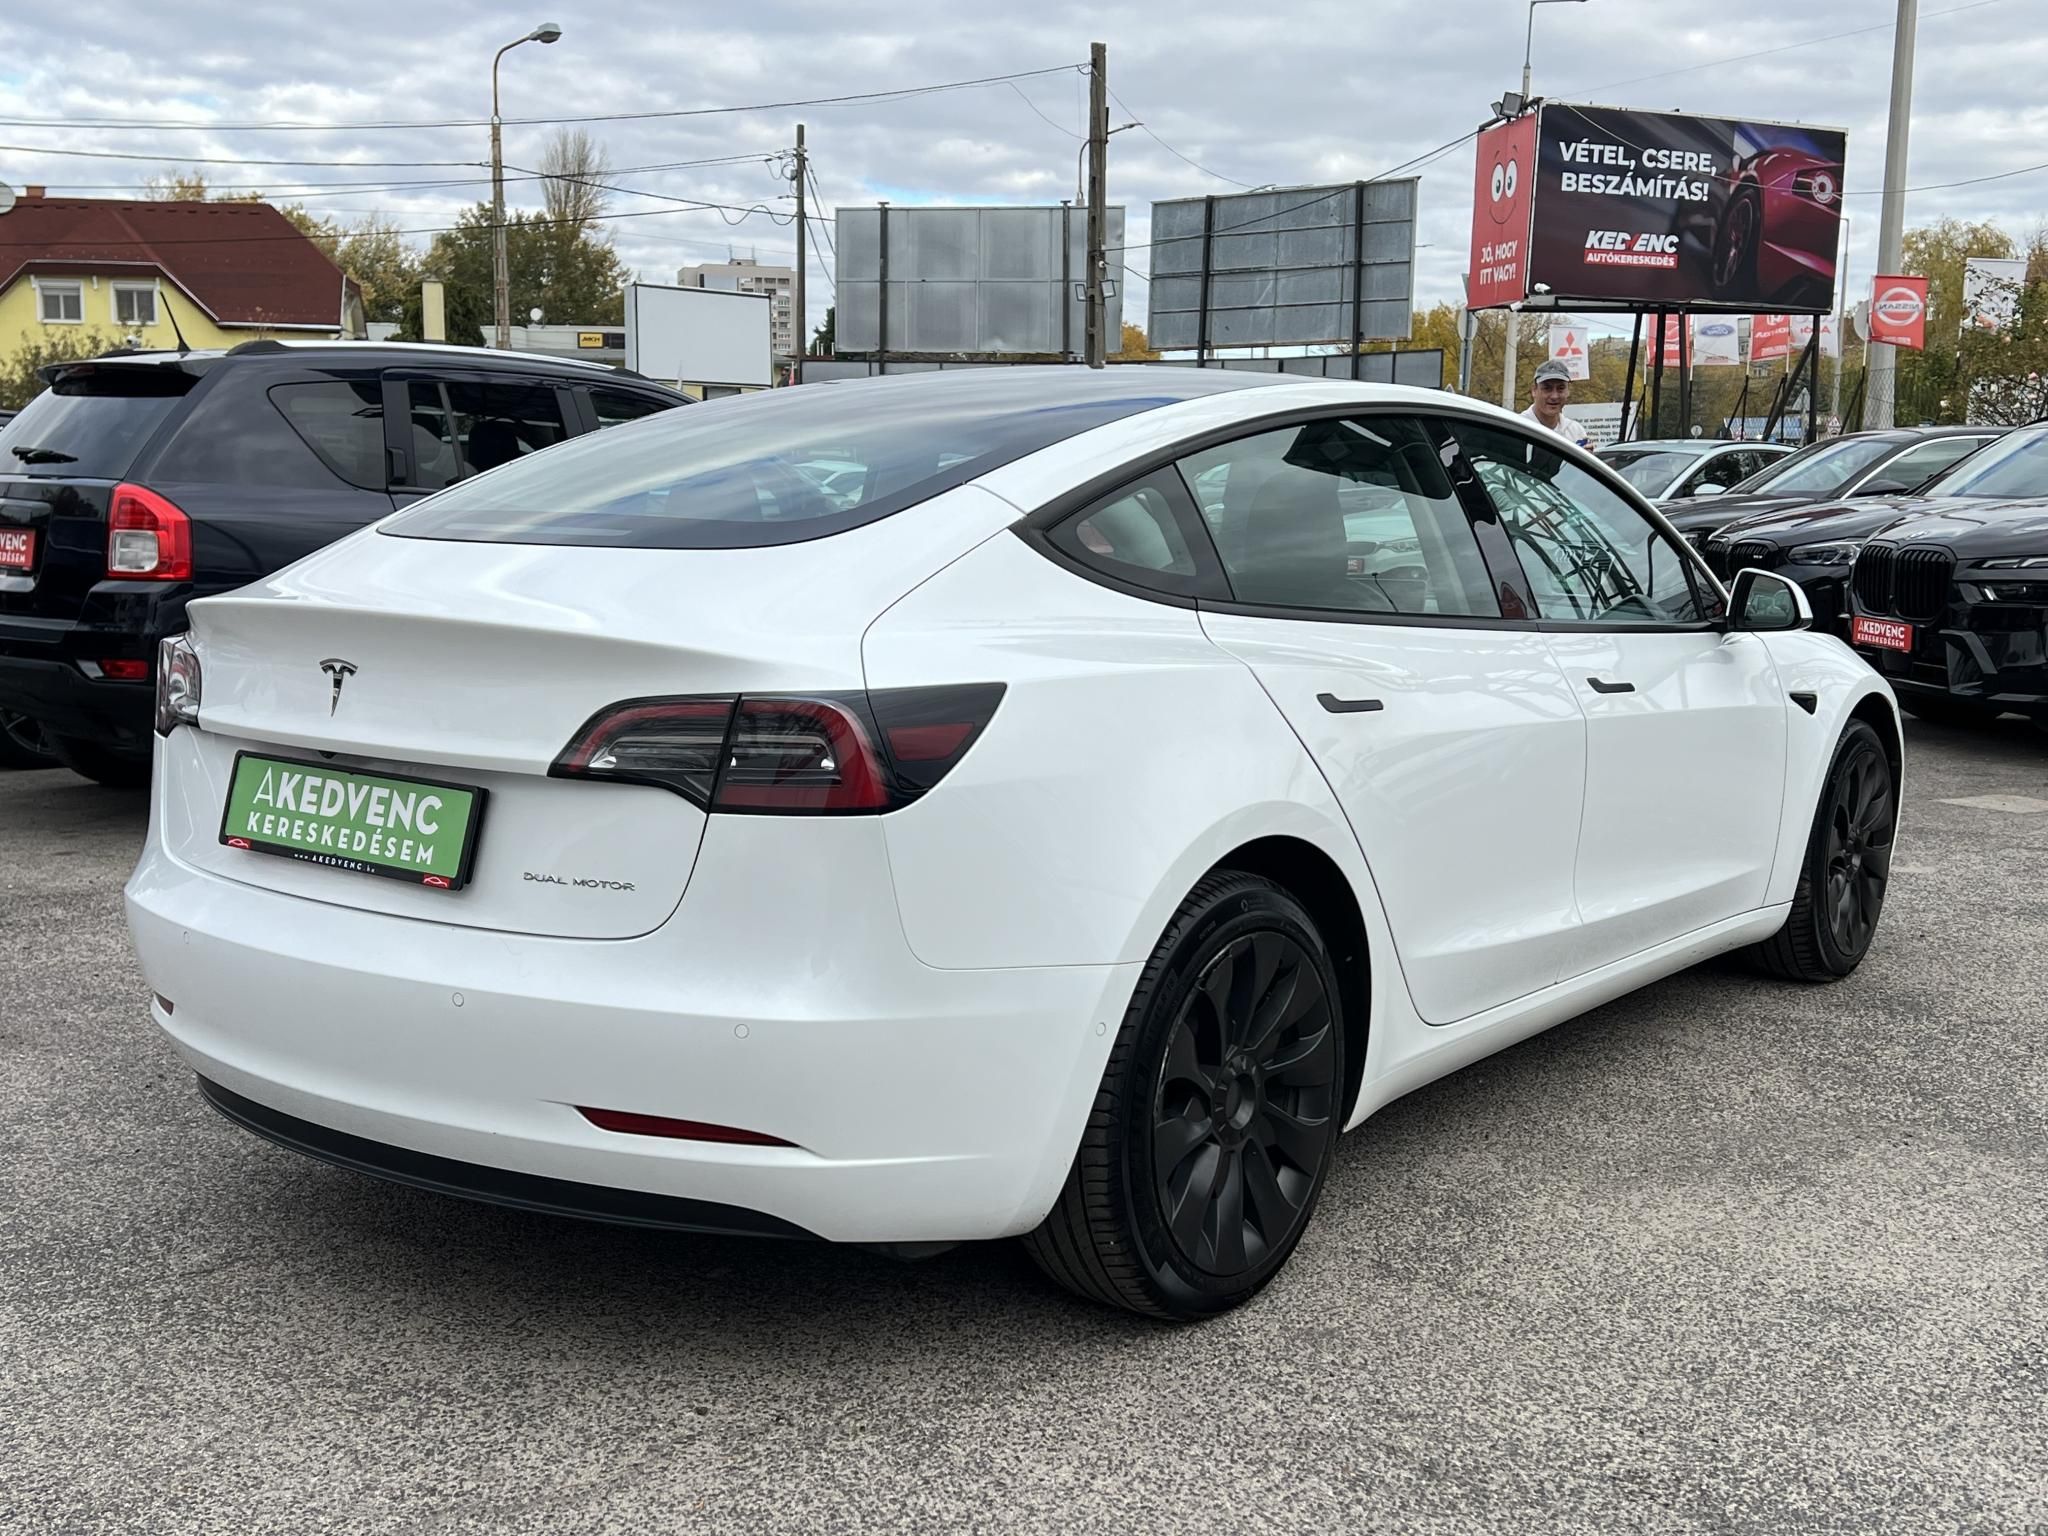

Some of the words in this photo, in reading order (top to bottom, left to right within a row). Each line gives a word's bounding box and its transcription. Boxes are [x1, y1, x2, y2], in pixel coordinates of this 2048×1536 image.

[1559, 139, 1636, 170] VÉTEL,
[1642, 148, 1717, 177] CSERE,
[1561, 171, 1710, 202] BESZÁMÍTÁS!
[1480, 244, 1494, 265] JÓ,
[1495, 240, 1518, 261] HOGY
[1586, 252, 1675, 267] AUTÓKERESKEDÉS
[1480, 267, 1493, 285] ITT
[1493, 263, 1517, 283] VAGY!
[1858, 620, 1905, 639] AKEDVENC
[1858, 633, 1904, 647] KERESKEDÉSEM
[253, 766, 444, 836] AKEDVENC
[247, 811, 434, 866] KERESKEDÉSEM
[523, 871, 568, 885] DUAL
[572, 878, 636, 892] MOTOR
